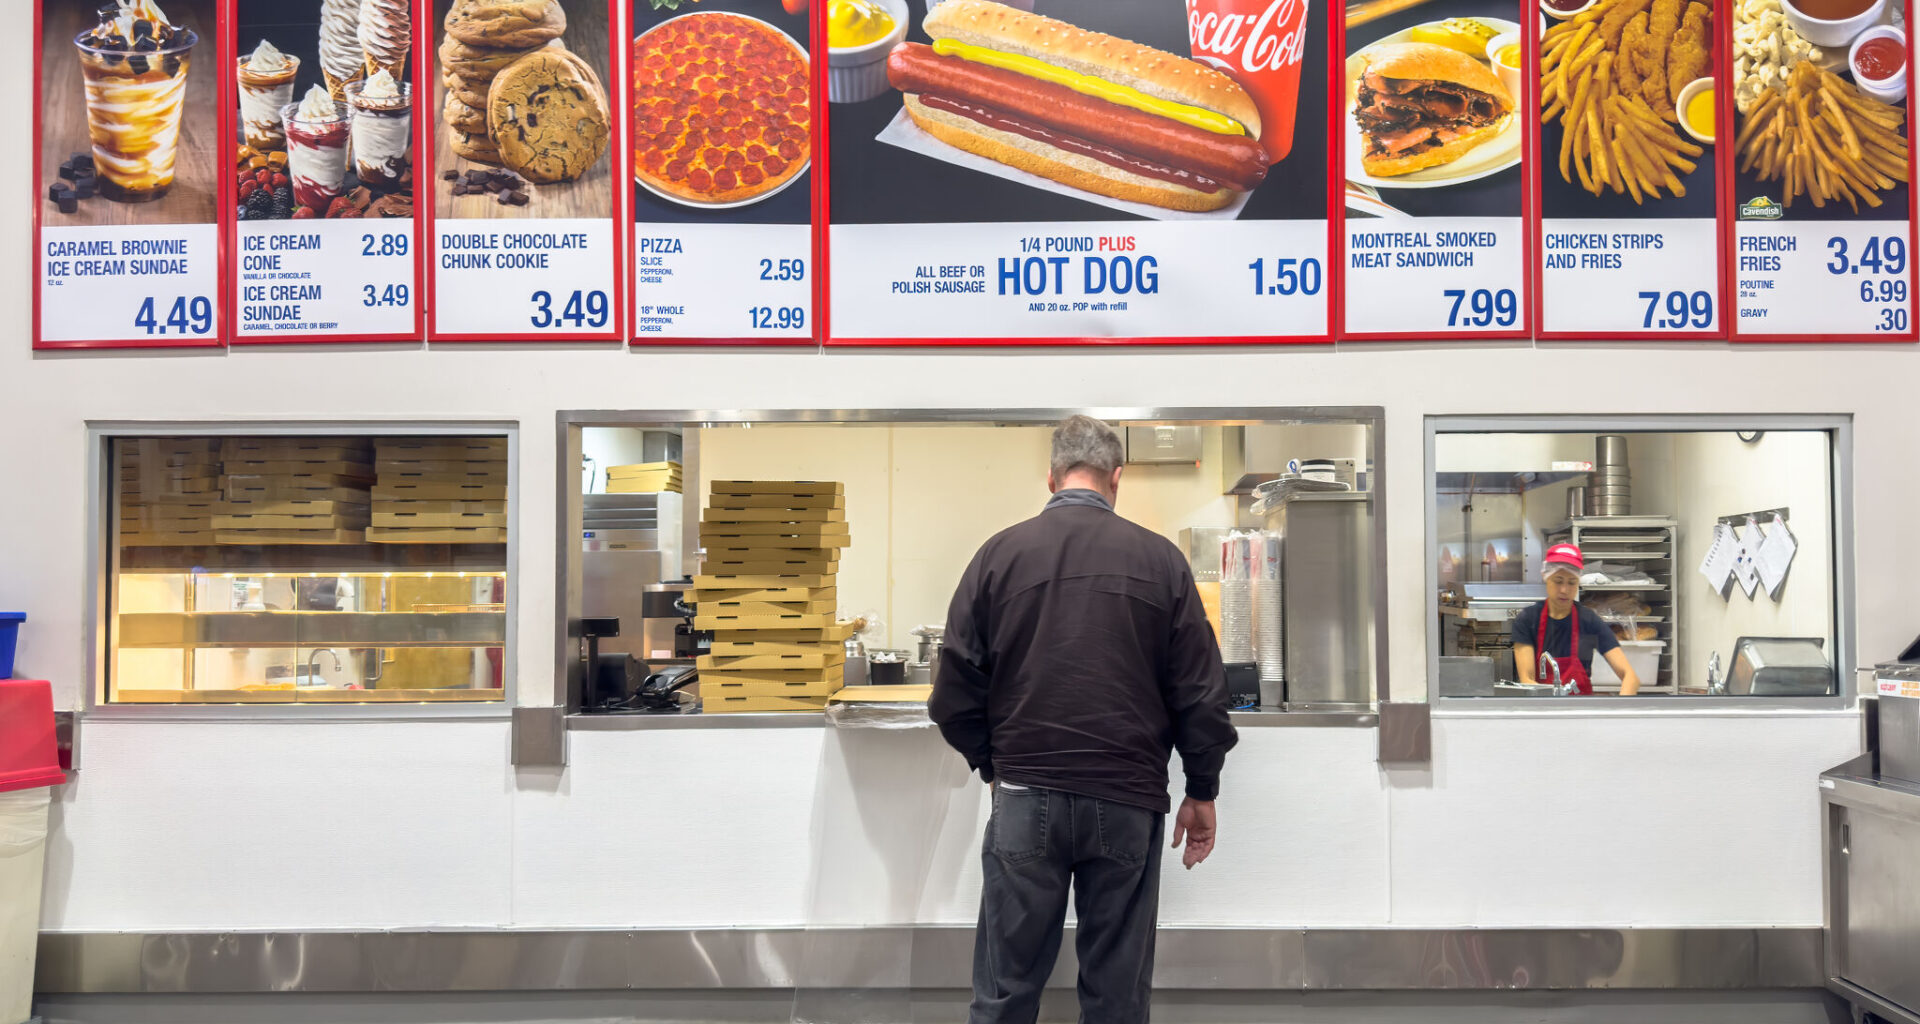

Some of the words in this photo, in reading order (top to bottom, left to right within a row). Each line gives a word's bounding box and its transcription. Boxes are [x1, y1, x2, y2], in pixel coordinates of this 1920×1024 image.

[1742, 206, 1780, 216] Cavendish
[48, 241, 117, 256] CARAMEL
[122, 240, 187, 255] BROWNIE
[244, 236, 265, 251] ICE
[270, 235, 320, 250] CREAM
[362, 234, 408, 256] 2.89
[442, 234, 498, 249] DOUBLE
[503, 234, 587, 249] CHOCOLATE
[641, 238, 682, 253] PIZZA
[1020, 237, 1041, 252] 1/4
[1046, 237, 1093, 252] POUND
[1099, 236, 1135, 251] PLUS
[1352, 232, 1431, 248] MONTREAL
[1436, 232, 1496, 247] SMOKED
[1546, 234, 1607, 249] CHICKEN
[1613, 234, 1663, 249] STRIPS
[1740, 236, 1796, 251] FRENCH
[244, 255, 281, 270] CONE
[442, 254, 491, 269] CHUNK
[496, 254, 548, 268] COOKIE
[641, 257, 662, 266] SLICE
[1352, 253, 1391, 268] MEAT
[1396, 252, 1473, 267] SANDWICH
[1546, 254, 1576, 268] AND
[1582, 254, 1622, 269] FRIES
[1741, 256, 1781, 271] FRIES
[1827, 236, 1906, 275] 3.49
[48, 261, 70, 276] ICE
[75, 260, 125, 276] CREAM
[130, 259, 188, 275] SUNDAE
[641, 268, 673, 277] PEPPERONI,
[760, 259, 804, 281] 2.59
[916, 266, 936, 278] ALL
[940, 266, 966, 278] BEEF
[970, 266, 984, 277] OR
[998, 257, 1069, 295] HOT
[1084, 256, 1158, 294] DOG
[1249, 258, 1321, 295] 1.50
[1740, 280, 1774, 289] POUTINE
[244, 286, 266, 301] ICE
[271, 285, 321, 300] CREAM
[363, 284, 408, 306] 3.49
[892, 281, 930, 293] POLISH
[935, 281, 985, 293] SAUSAGE
[1861, 280, 1907, 303] 6.99
[244, 305, 301, 321] SUNDAE
[531, 290, 608, 328] 3.49
[657, 306, 684, 314] WHOLE
[1029, 303, 1045, 312] AND
[1048, 303, 1057, 311] 20
[1073, 302, 1088, 311] POP
[1091, 302, 1107, 311] with
[1110, 302, 1127, 310] refill
[1444, 289, 1517, 326] 7.99
[1639, 291, 1712, 328] 7.99
[1741, 309, 1767, 317] GRAVY
[135, 296, 212, 335] 4.49
[641, 317, 672, 326] PEPPERONI,
[749, 307, 804, 329] 12.99
[1875, 308, 1907, 331] .30
